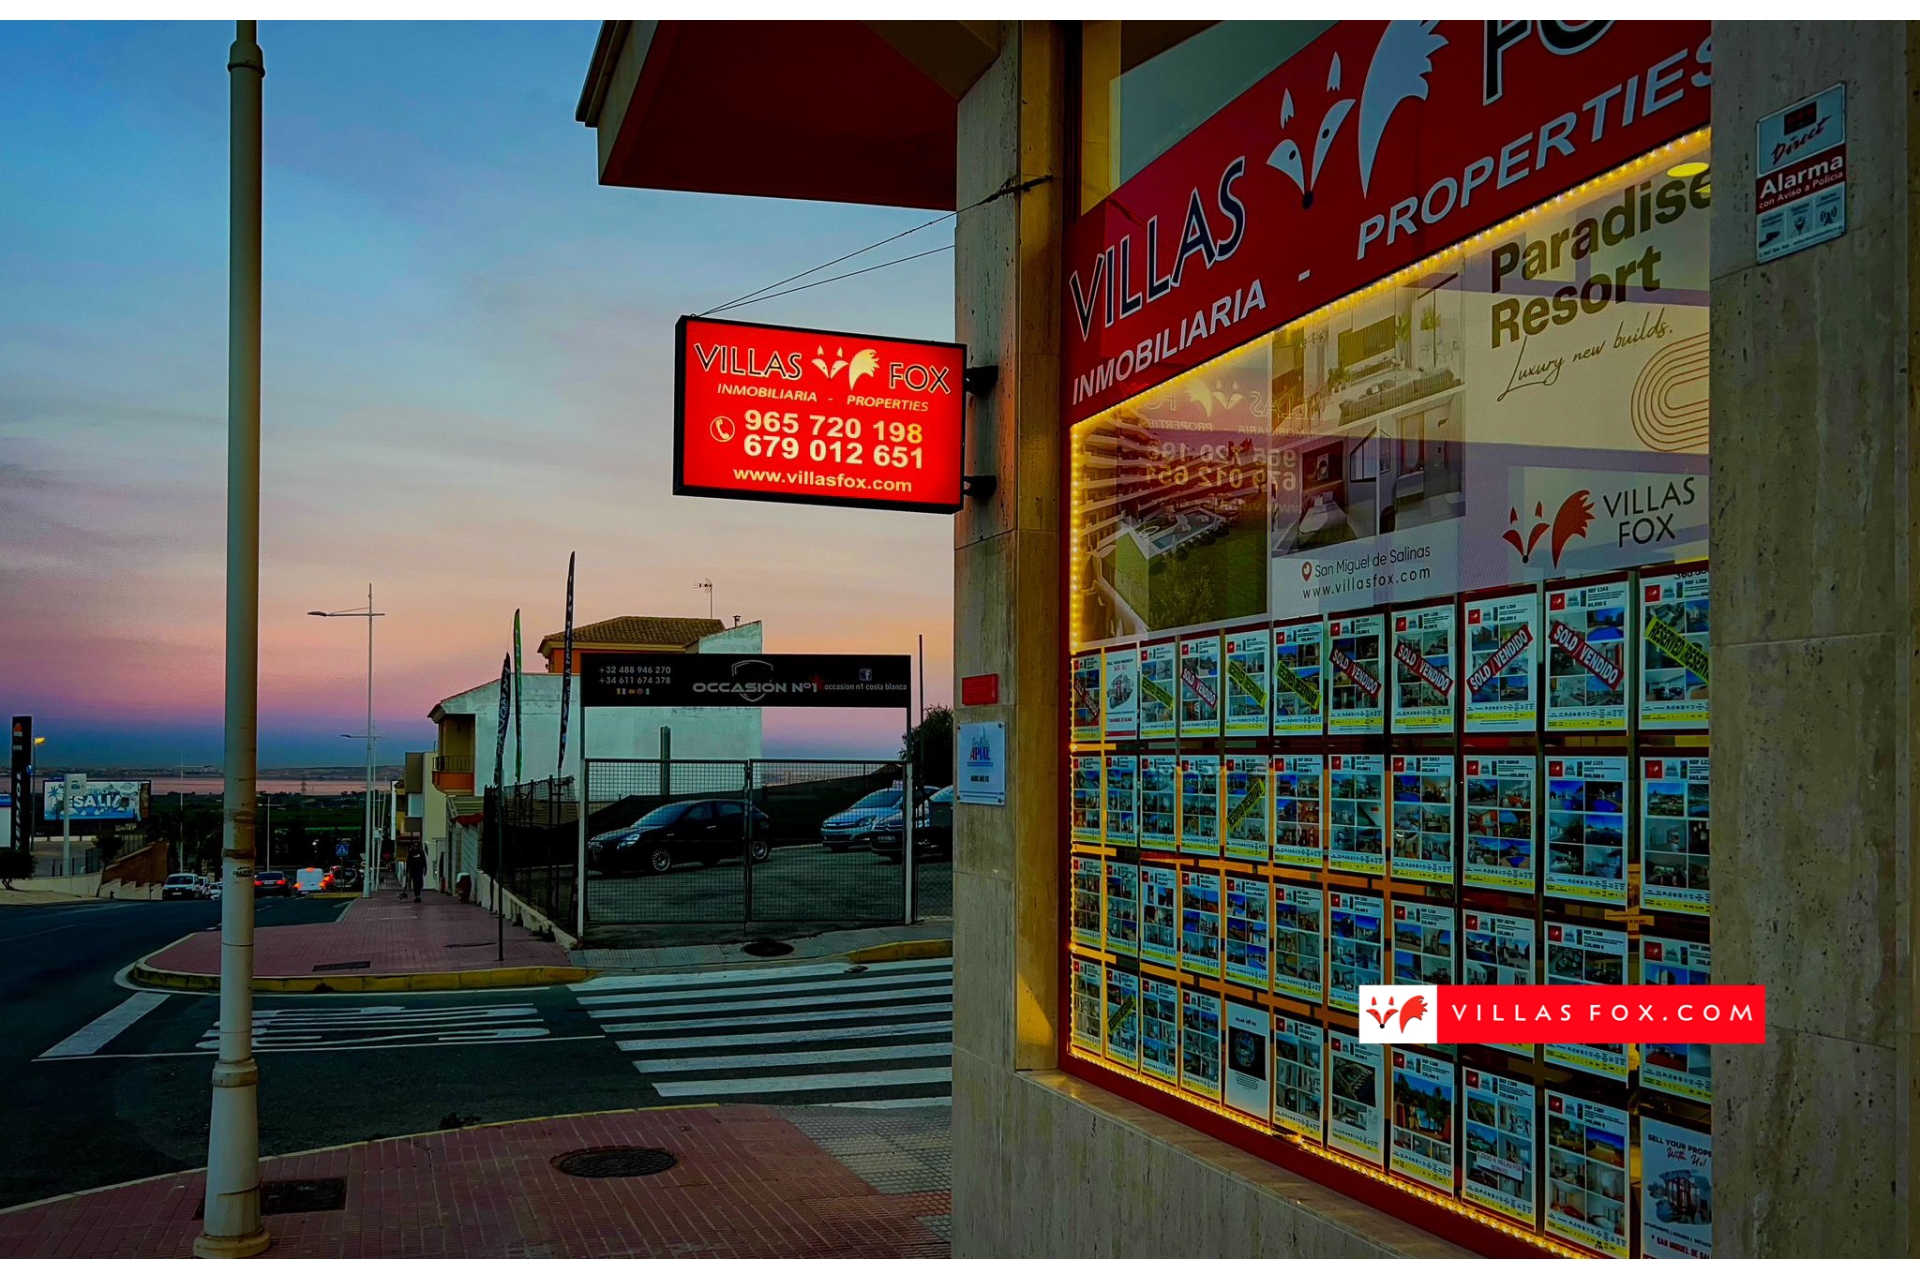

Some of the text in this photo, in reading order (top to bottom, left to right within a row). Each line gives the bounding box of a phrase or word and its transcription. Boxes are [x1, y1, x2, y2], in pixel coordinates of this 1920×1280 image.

[1760, 156, 1844, 199] Alarma
[1759, 197, 1775, 210] con
[1777, 187, 1802, 203] Aviso
[1804, 184, 1810, 192] a
[1491, 167, 1711, 294] Paradise
[1069, 155, 1246, 343] VILLAS
[1491, 243, 1661, 351] Resort
[1073, 279, 1266, 406] INMOBILIARIA
[1498, 306, 1674, 403] Luxury new builds.
[694, 343, 951, 395] VILLAS FOX
[717, 383, 818, 403] INMOBILIARIA
[847, 395, 929, 412] PROPERTIES
[744, 409, 923, 445] 965 720 198
[743, 434, 923, 470] 679 012 651
[733, 468, 912, 492] www.villasfox.com
[1603, 477, 1696, 518] VILLAS
[1618, 514, 1677, 549] FOX
[1315, 545, 1431, 579] San Miguel de Salinas
[1302, 567, 1431, 600] www.villasfox.com
[599, 666, 617, 674] +32
[655, 666, 671, 674] 270
[1332, 649, 1350, 670] SOLD
[1351, 664, 1378, 694] VENDIDO
[1397, 646, 1417, 666] SOLD
[1419, 661, 1450, 693] VENDIDO
[1470, 667, 1491, 691] SOLD
[1494, 630, 1528, 669] VENDIDO
[1554, 625, 1577, 651] SOLD
[1579, 647, 1619, 685] VENDIDO
[599, 676, 617, 684] +34
[824, 683, 855, 691] occasion
[865, 683, 884, 691] costa
[885, 682, 907, 691] blanca
[1648, 1133, 1664, 1145] SELL
[1665, 1138, 1686, 1150] YOUR
[1666, 1147, 1686, 1162] With
